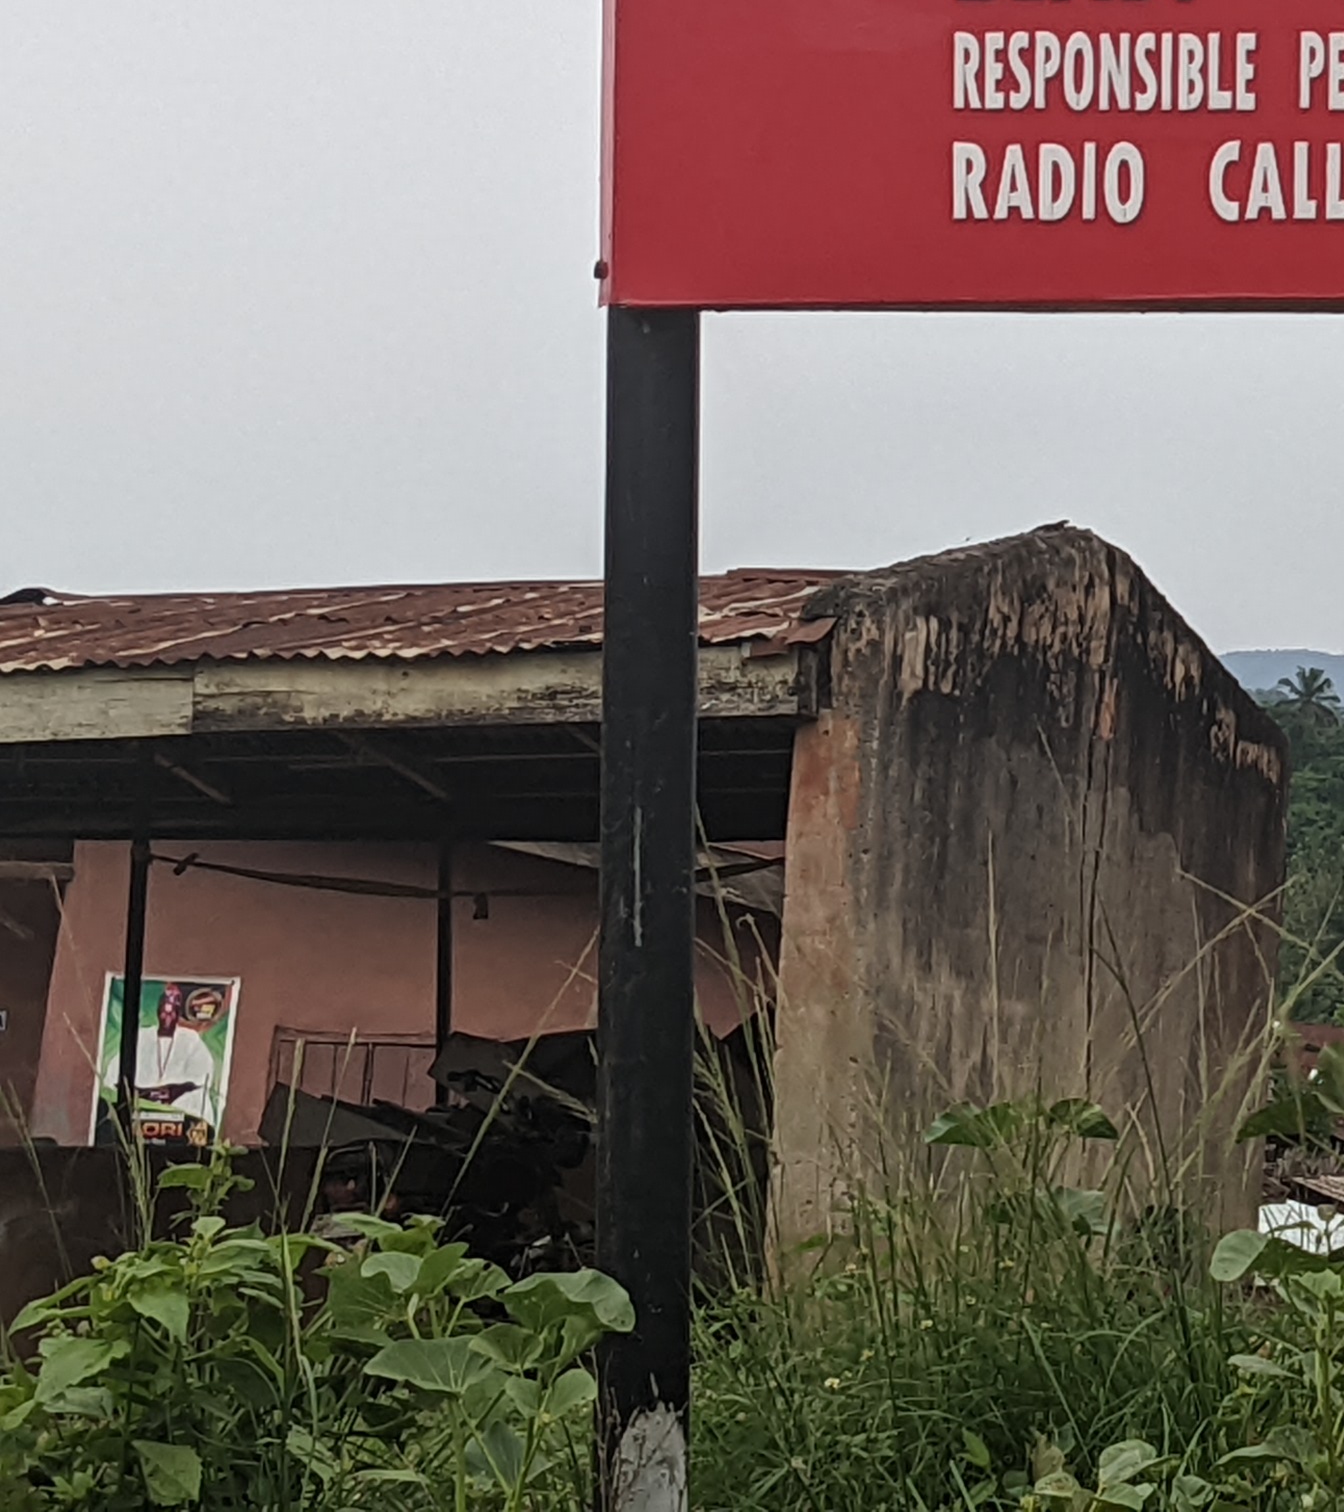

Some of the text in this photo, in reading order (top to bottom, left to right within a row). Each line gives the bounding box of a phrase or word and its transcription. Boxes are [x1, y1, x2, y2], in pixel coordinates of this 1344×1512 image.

[953, 30, 1257, 112] RESPONSIBLE
[952, 141, 1145, 224] RADIO
[133, 1122, 183, 1136] ORI
